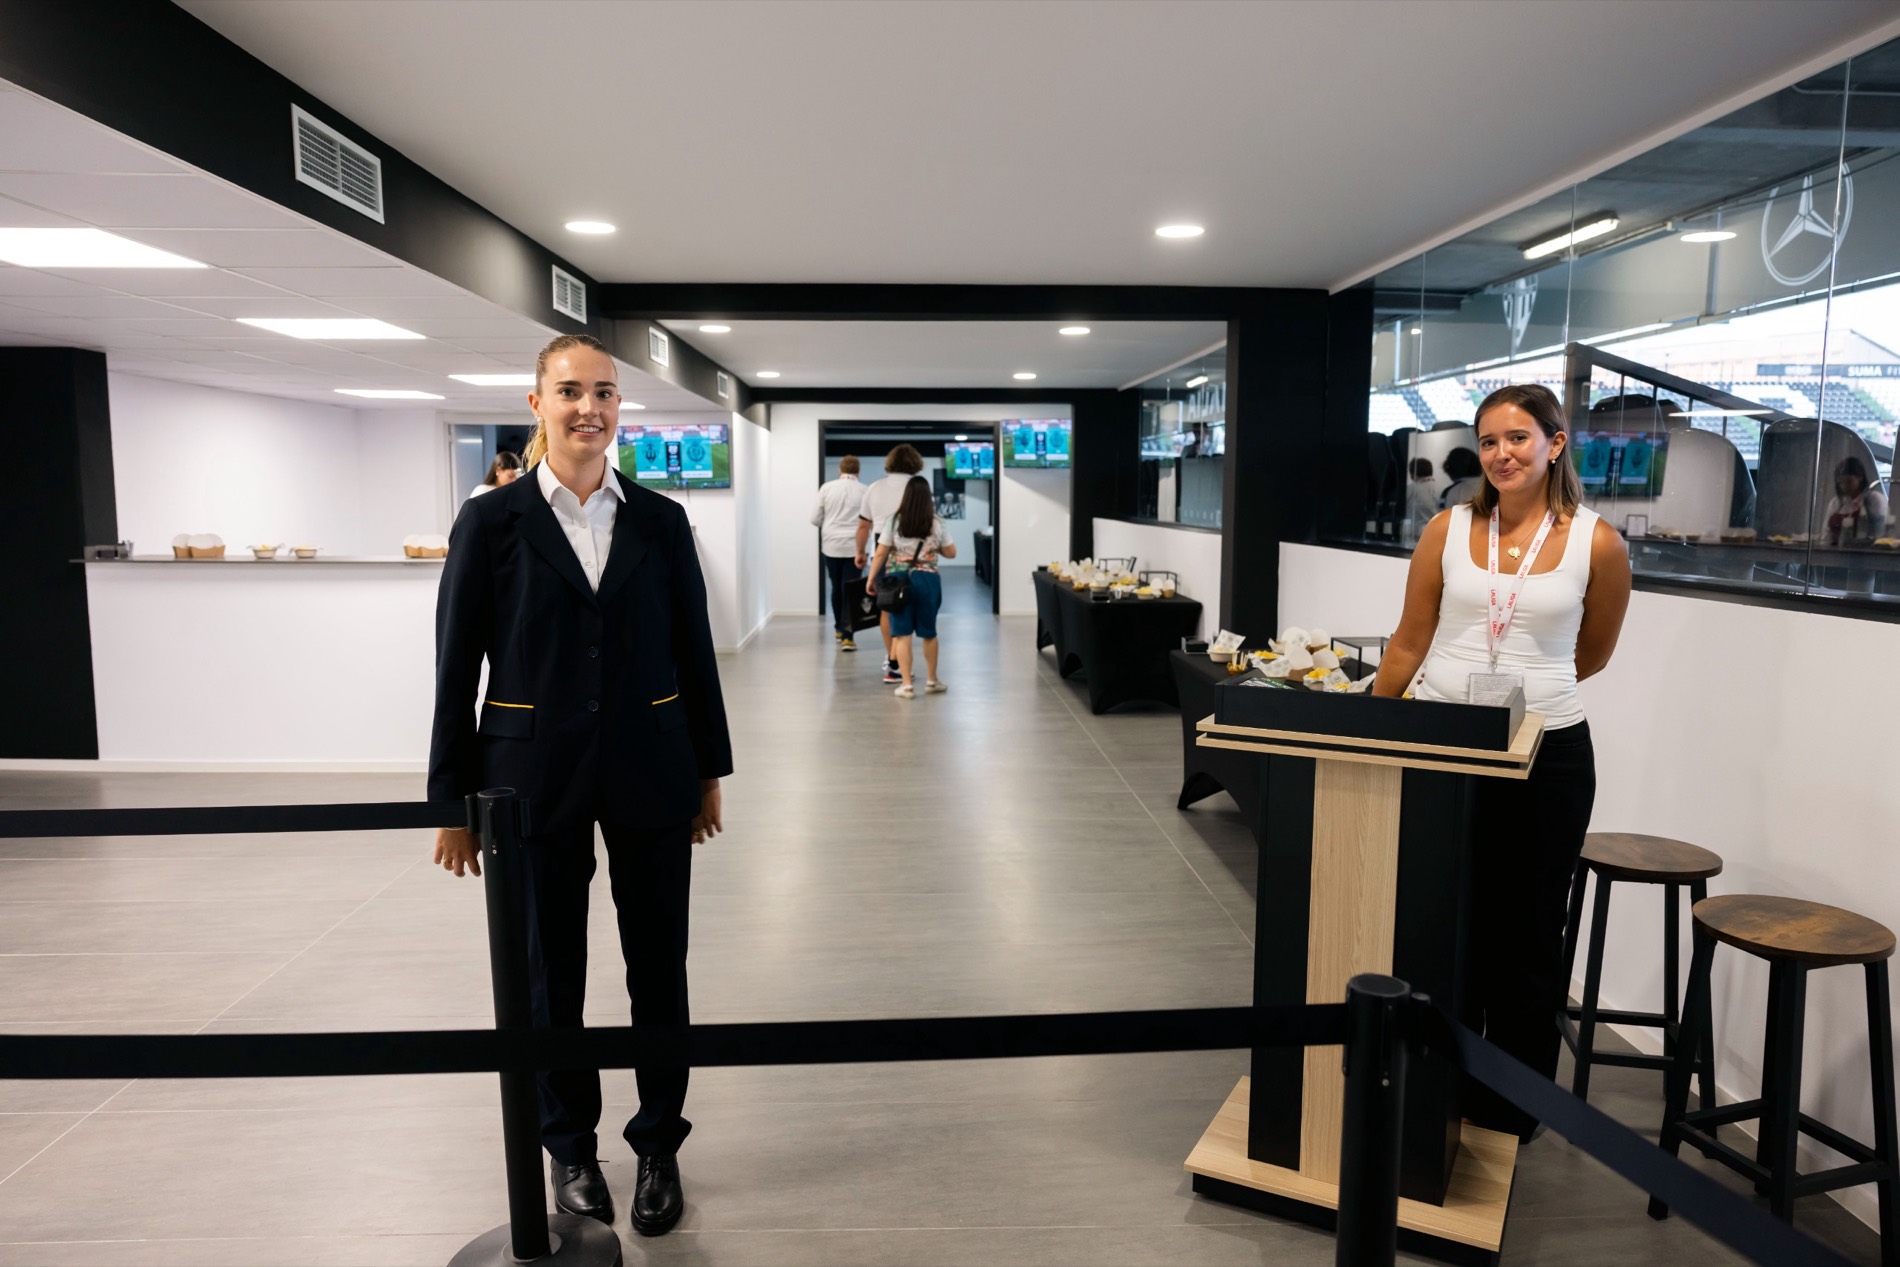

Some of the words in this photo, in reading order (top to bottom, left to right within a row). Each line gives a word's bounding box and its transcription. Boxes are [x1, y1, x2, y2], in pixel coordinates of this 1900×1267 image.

[1847, 365, 1882, 377] SUMA
[1532, 539, 1542, 553] LALIGA
[1519, 564, 1529, 579] LALIGA
[1507, 593, 1516, 608] LALIGA
